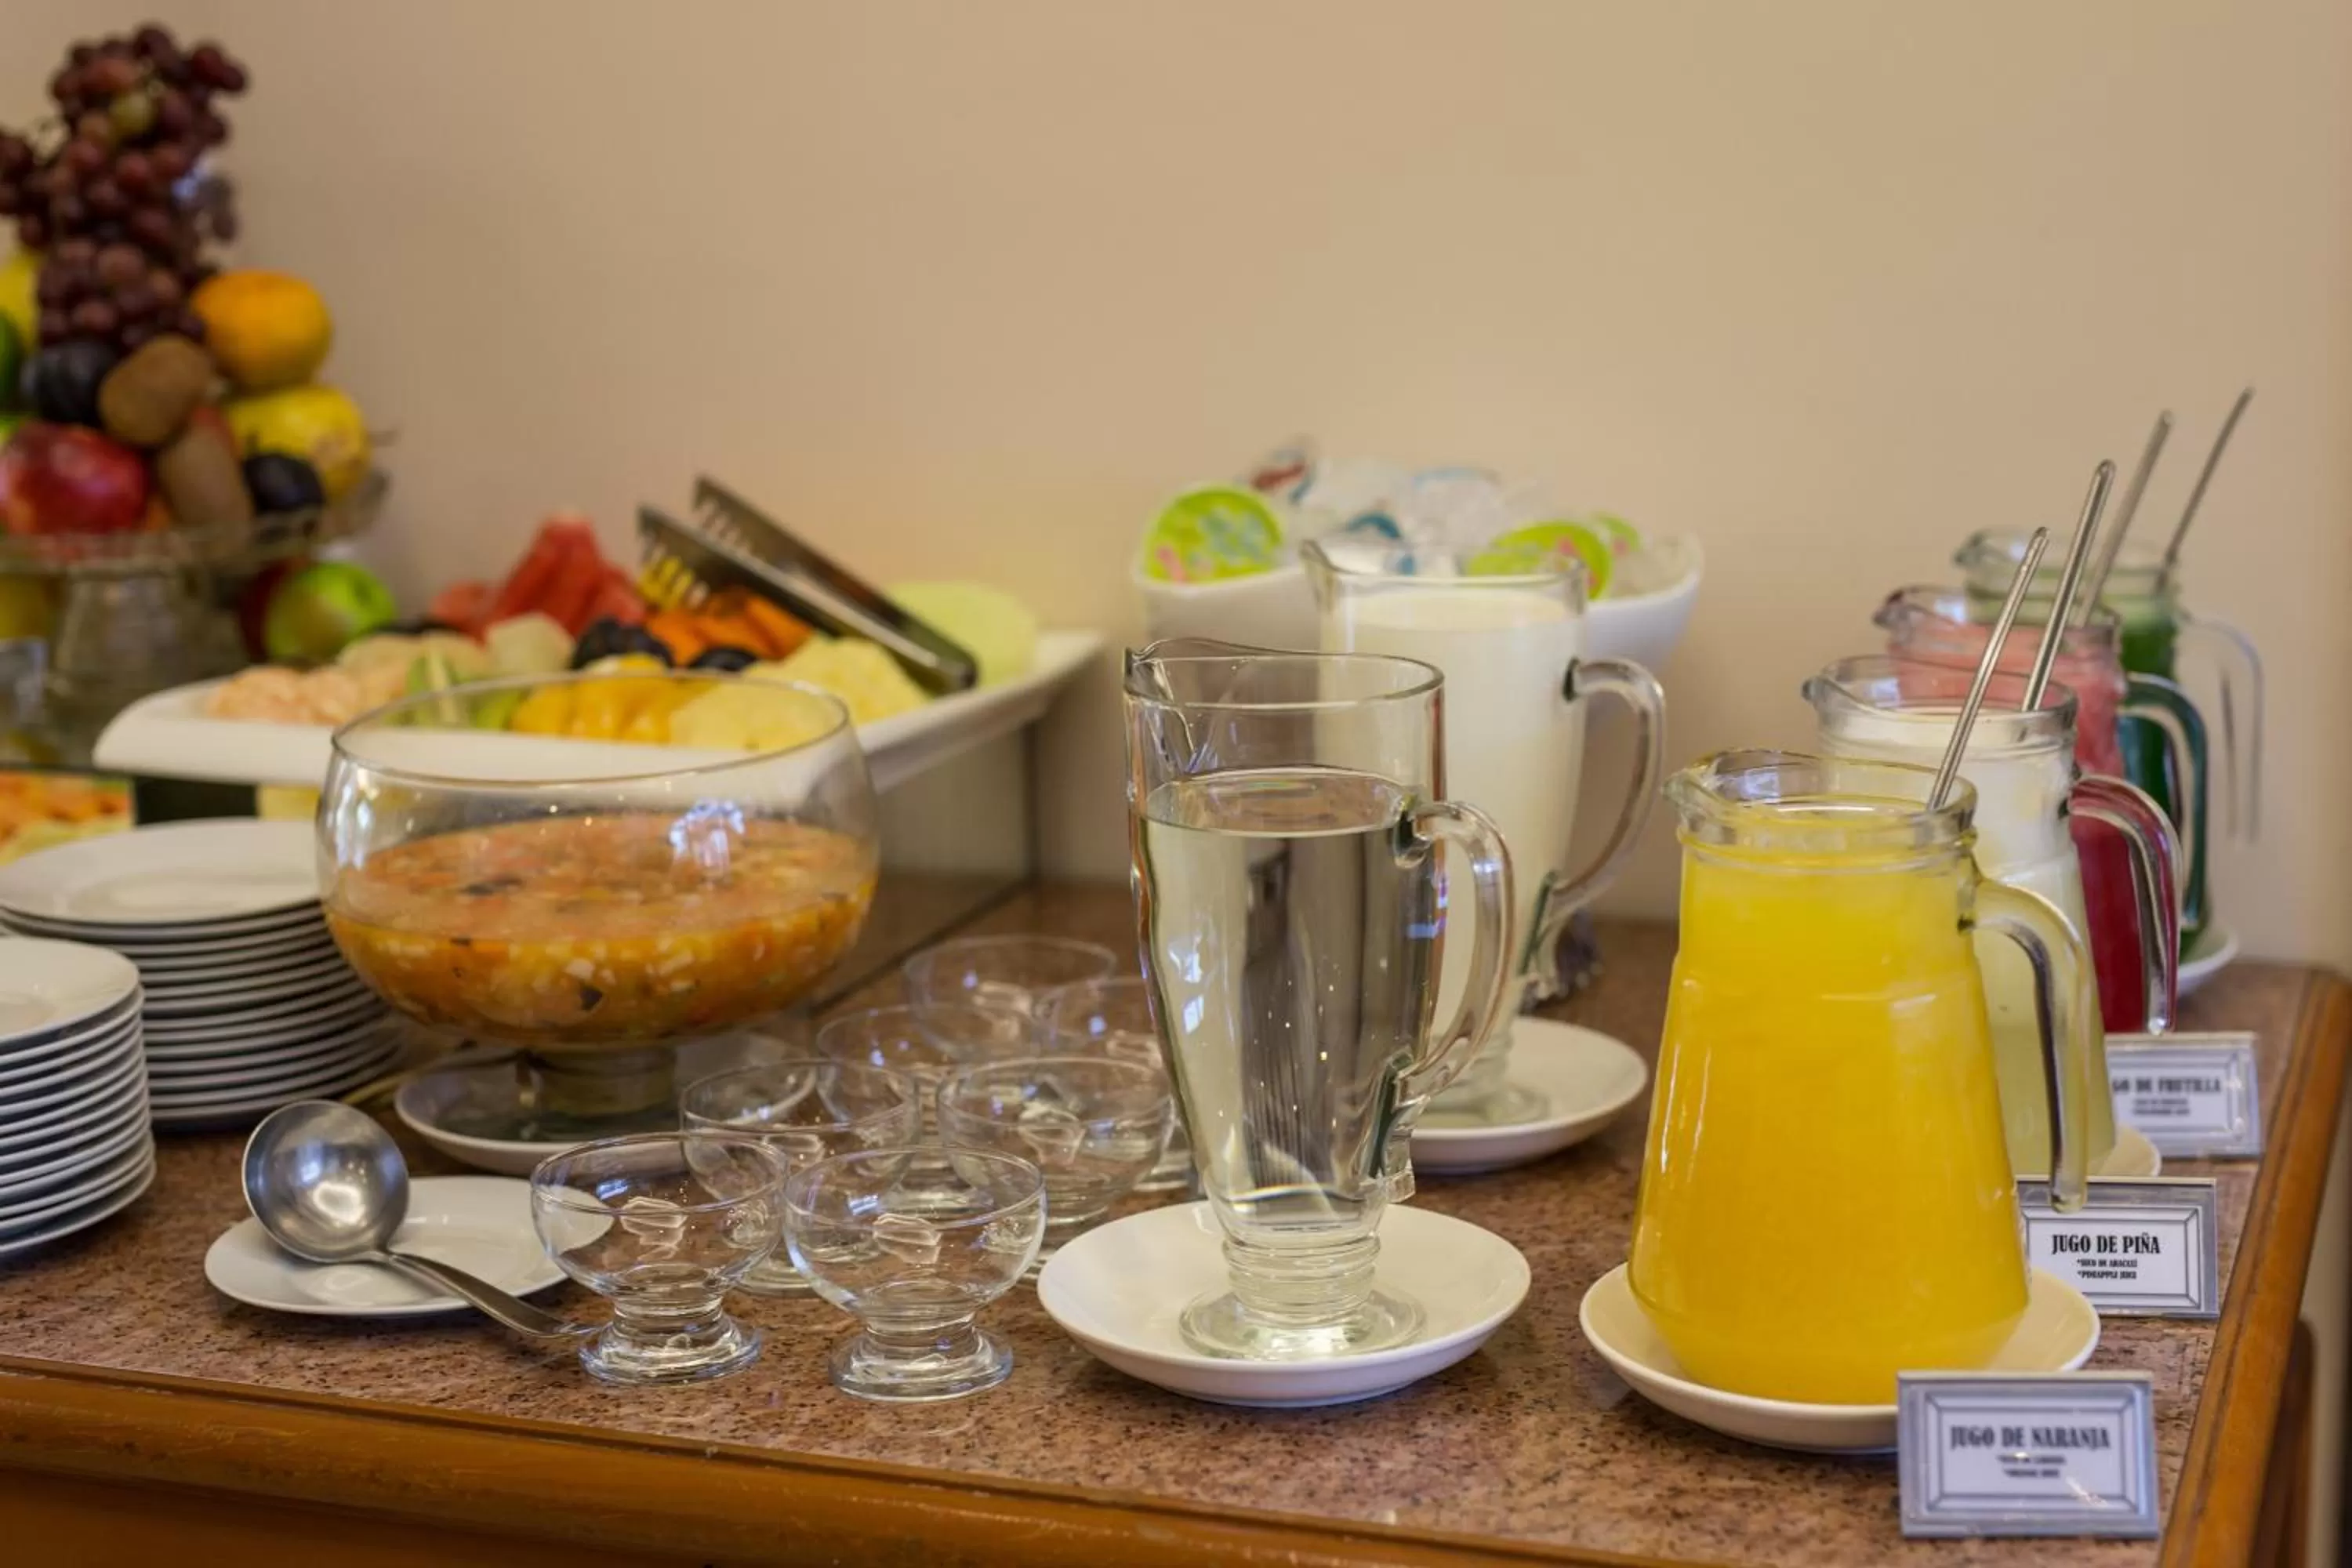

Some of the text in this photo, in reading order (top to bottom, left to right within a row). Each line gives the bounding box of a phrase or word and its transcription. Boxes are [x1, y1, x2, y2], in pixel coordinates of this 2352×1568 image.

[2052, 1232, 2160, 1254] JUGO DE PIÑA
[1951, 1425, 2111, 1450] JUGO DE NARANJA
